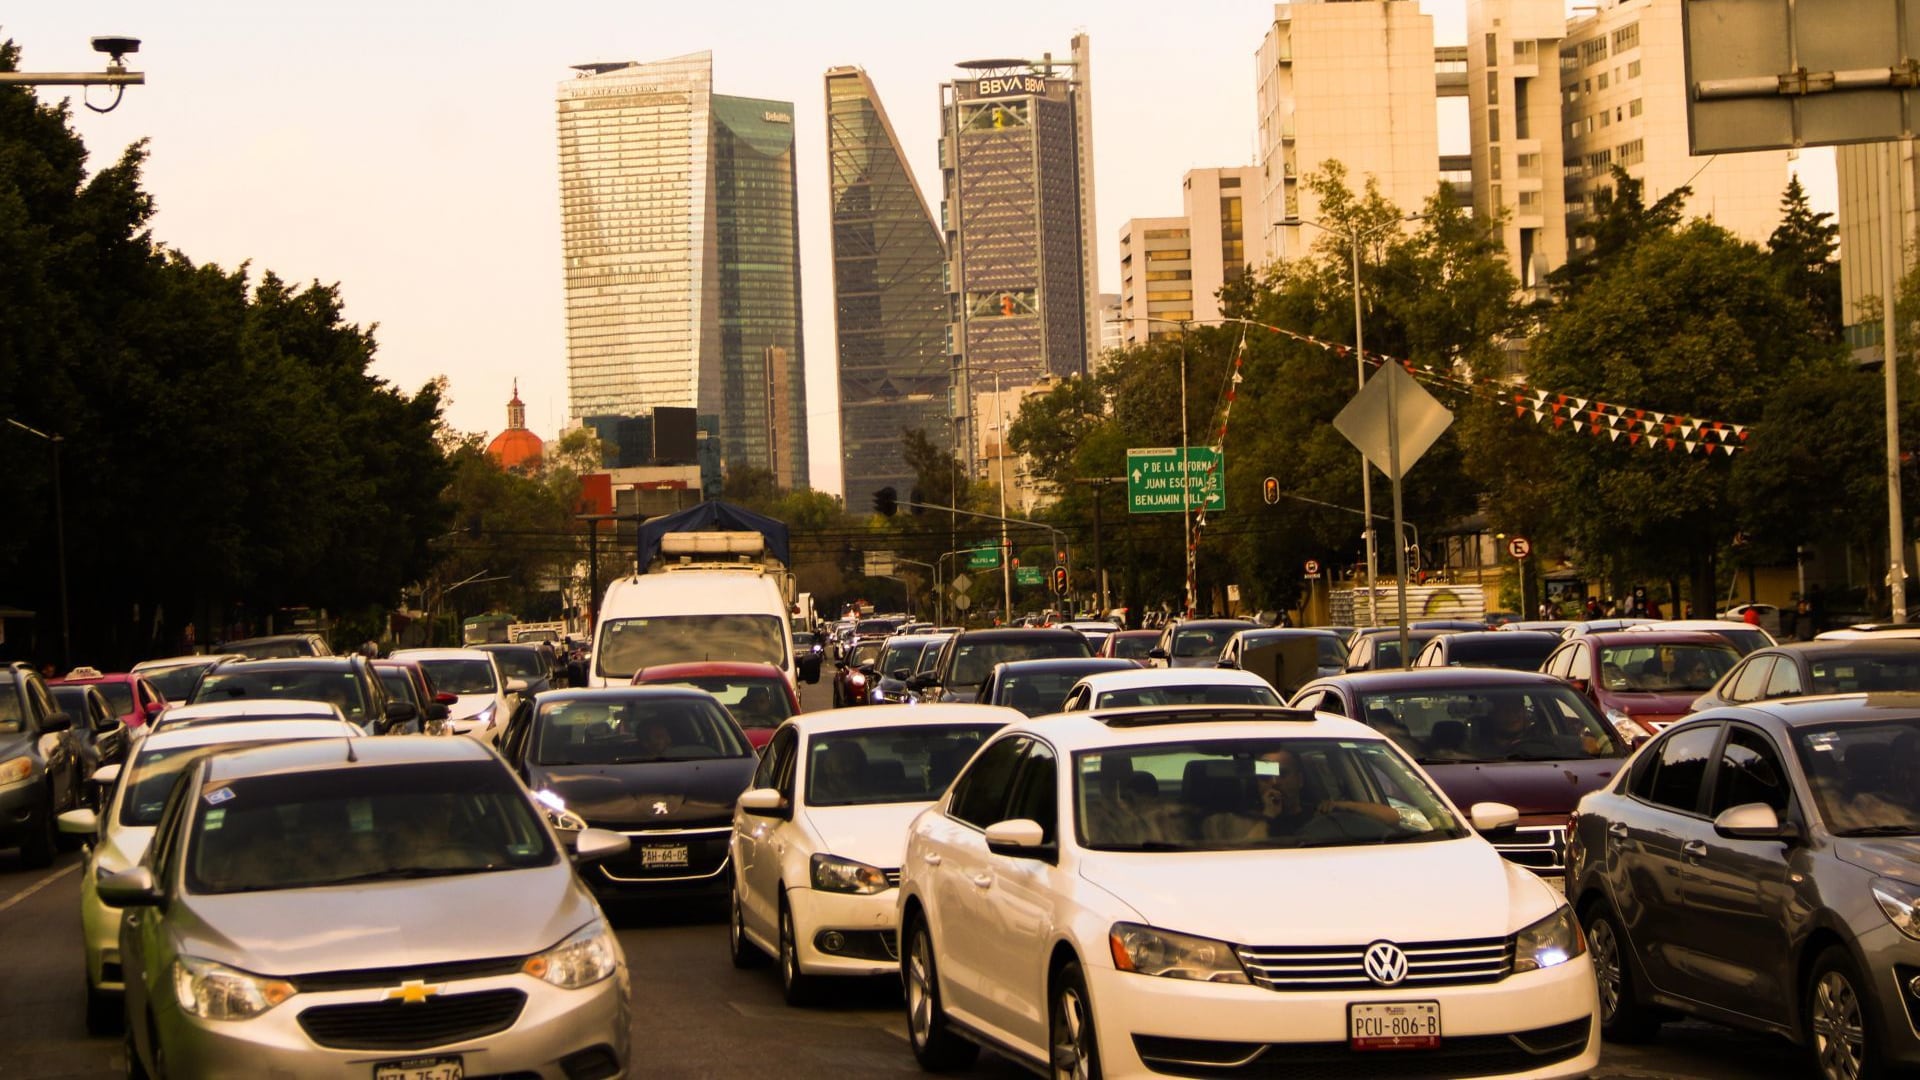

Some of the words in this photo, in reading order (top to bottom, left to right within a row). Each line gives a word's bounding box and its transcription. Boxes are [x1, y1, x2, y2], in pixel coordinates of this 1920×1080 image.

[980, 76, 1022, 94] BBVA
[1025, 78, 1046, 92] BBVA
[1143, 462, 1149, 473] P
[1151, 462, 1161, 473] DE
[1164, 461, 1175, 473] LA
[1177, 460, 1213, 472] RFORMA
[1144, 478, 1166, 490] JUAN
[1135, 494, 1180, 506] BENJAMIN
[642, 850, 688, 861] PAH-64-05
[1356, 1016, 1436, 1037] PCU-806-B
[378, 1068, 460, 1080] -75-76
